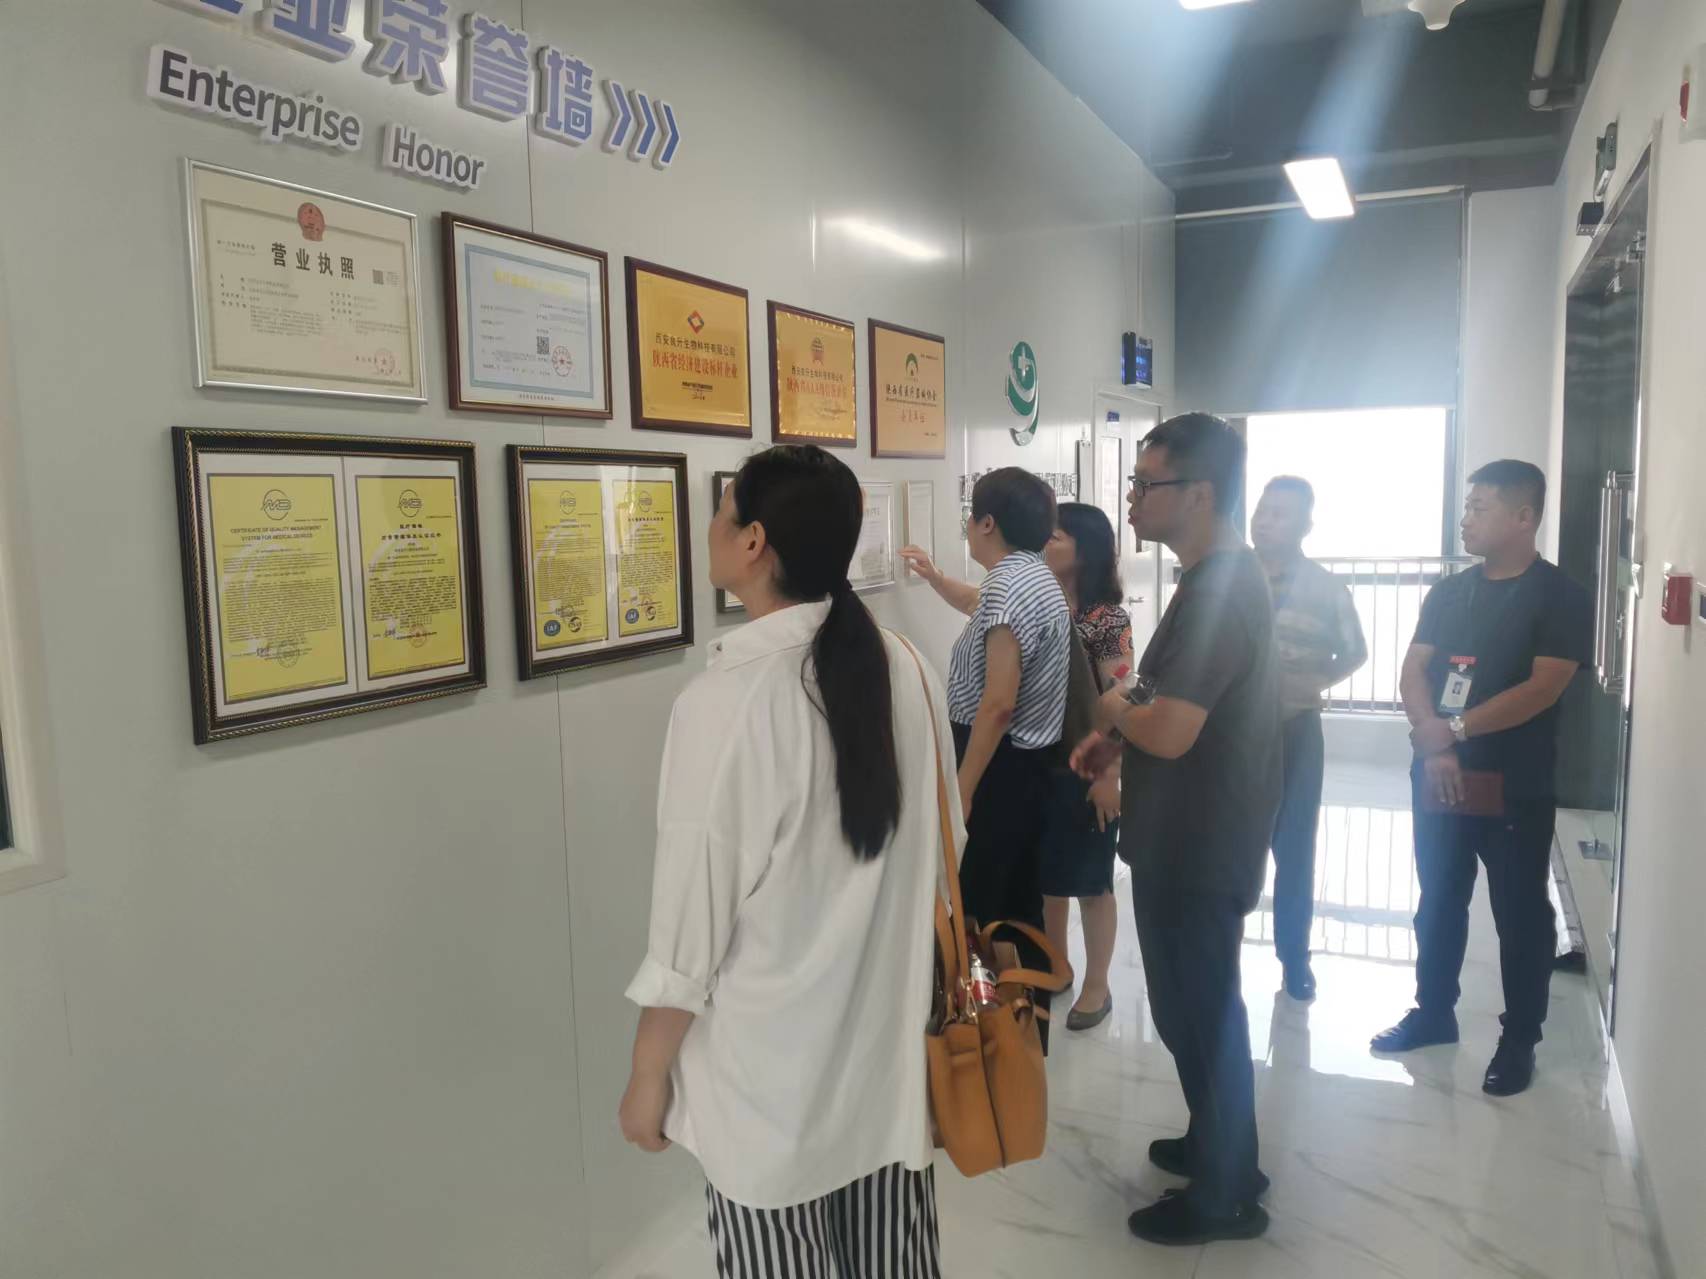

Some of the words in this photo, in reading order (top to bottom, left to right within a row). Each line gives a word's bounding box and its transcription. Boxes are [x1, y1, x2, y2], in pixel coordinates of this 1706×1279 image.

[160, 50, 360, 146] Enterprise
[392, 126, 484, 185] Honor
[271, 242, 355, 280] 营业执照
